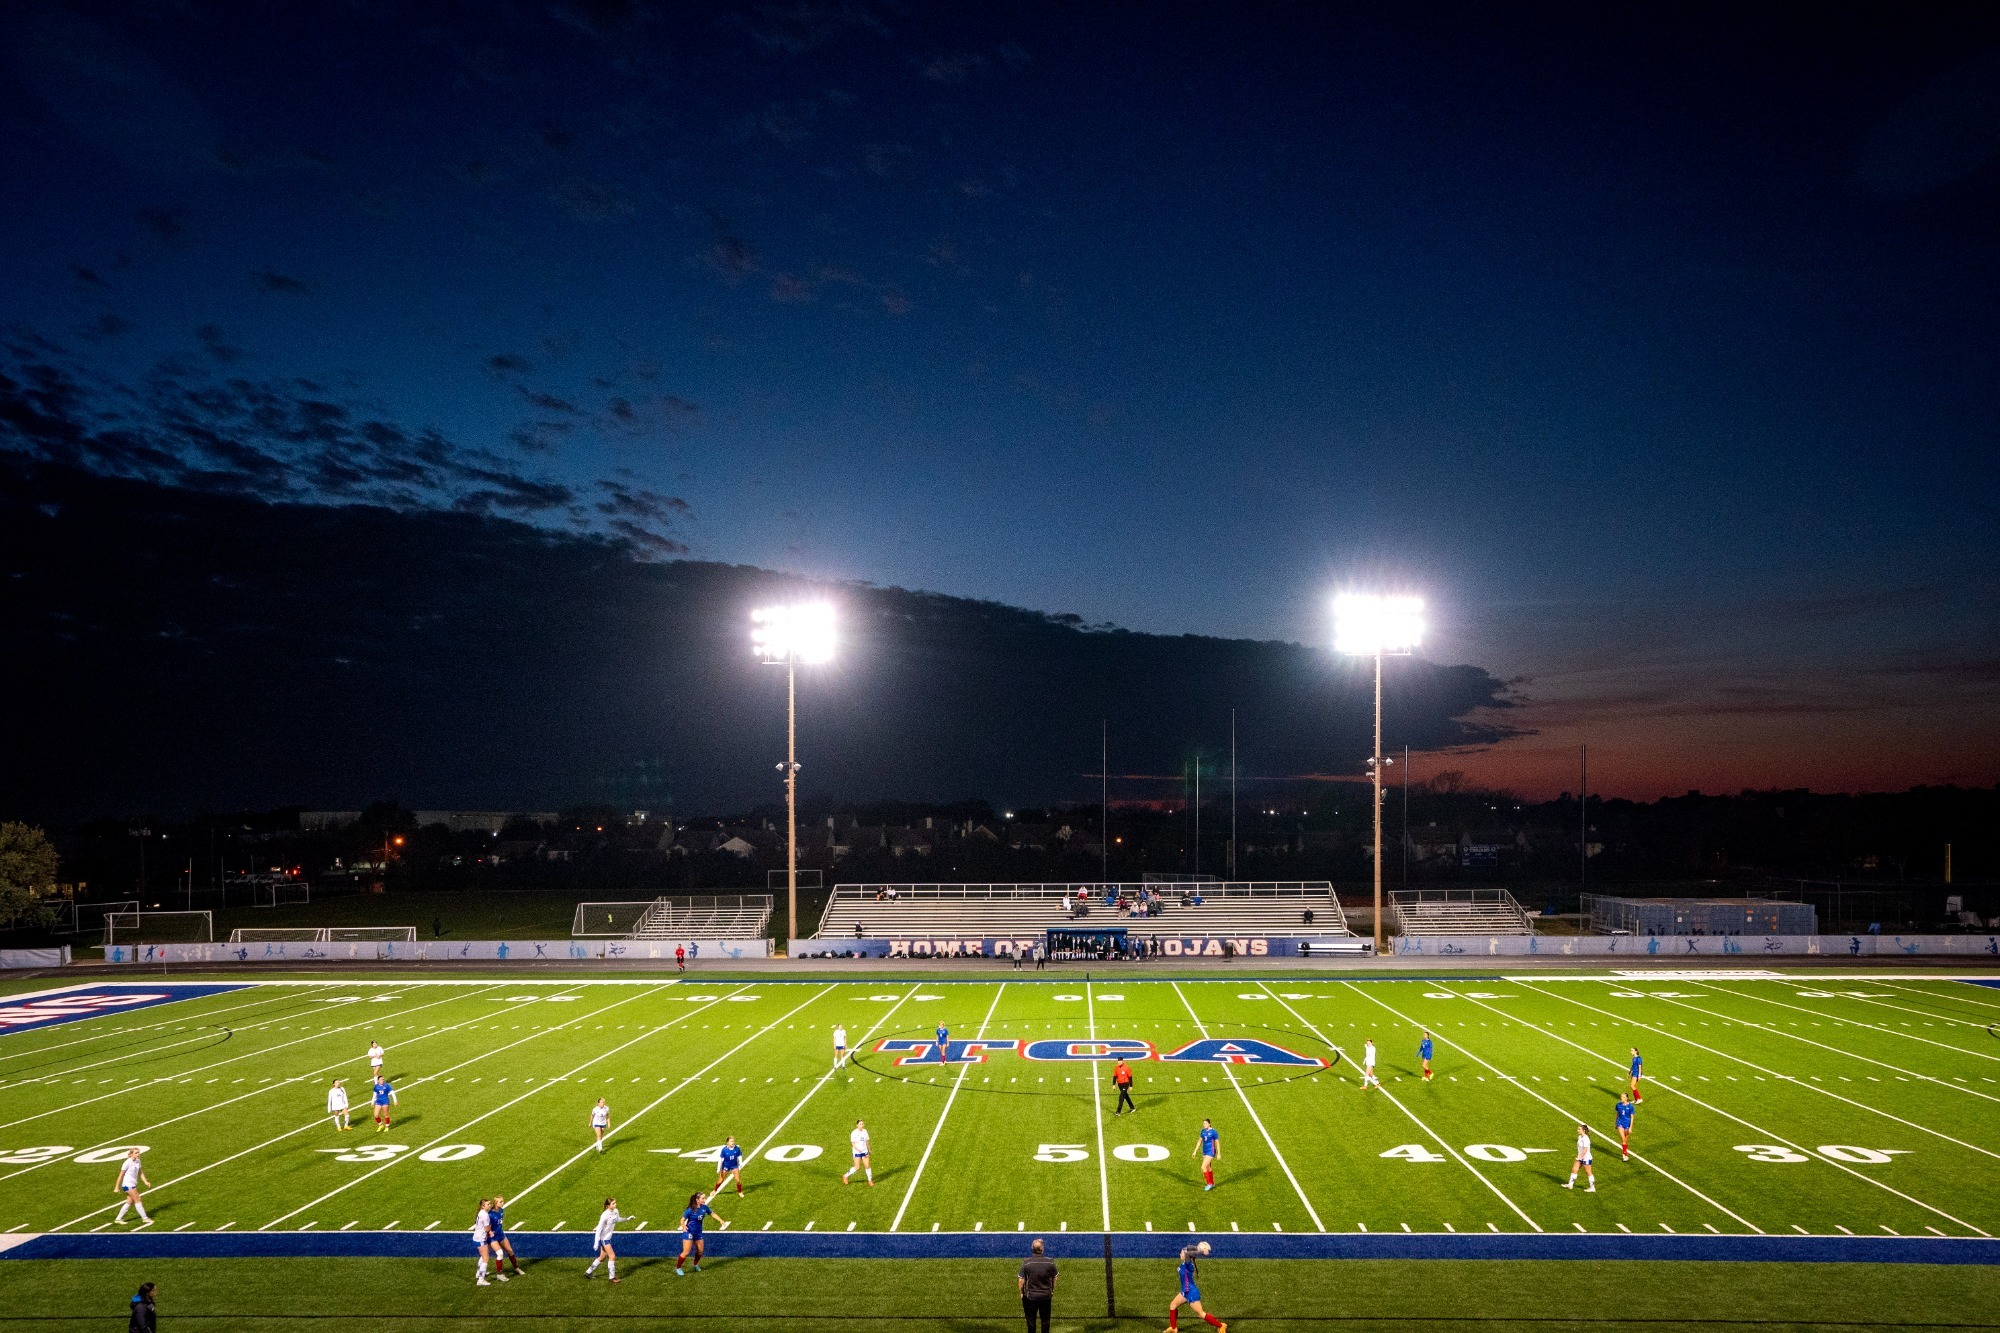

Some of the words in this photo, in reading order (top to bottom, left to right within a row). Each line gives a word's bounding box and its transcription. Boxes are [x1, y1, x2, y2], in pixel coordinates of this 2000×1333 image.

[889, 940, 982, 957] HOME
[994, 940, 1034, 956] OF
[873, 1038, 1331, 1068] TCA
[334, 1144, 485, 1162] 30
[677, 1144, 824, 1162] 40
[1032, 1143, 1171, 1163] 50
[1378, 1143, 1528, 1163] 40
[1732, 1144, 1892, 1164] 30
